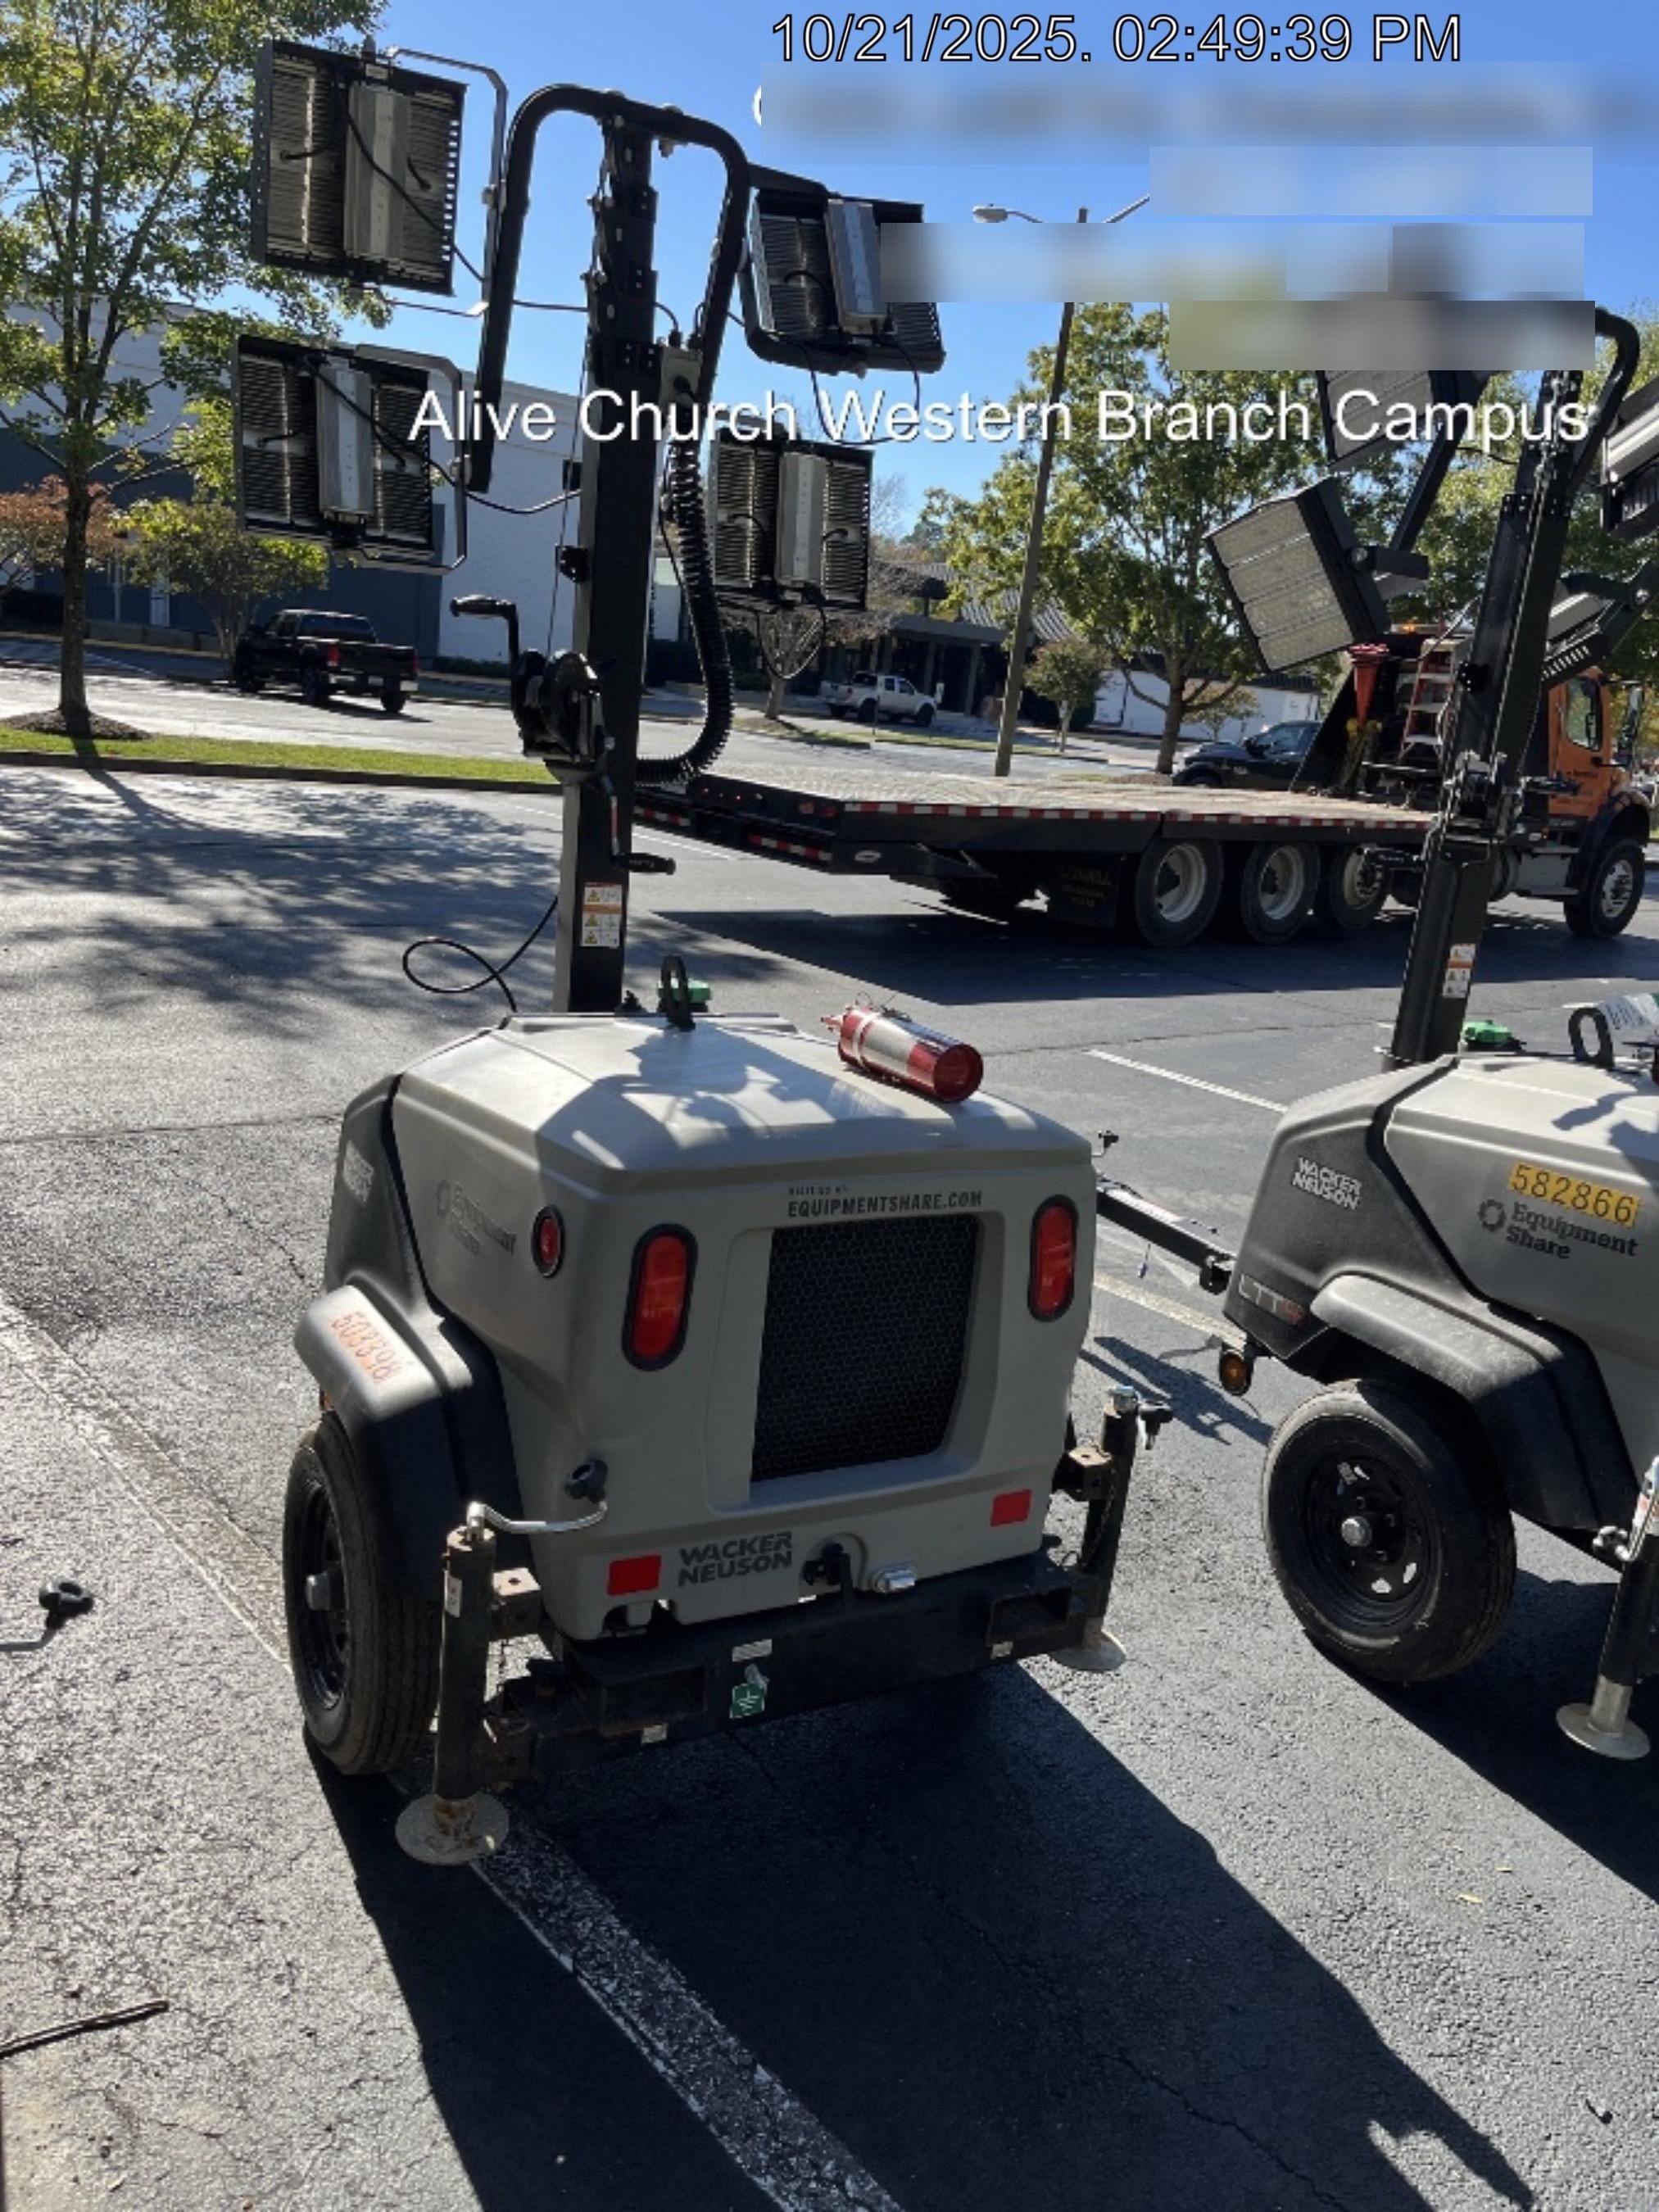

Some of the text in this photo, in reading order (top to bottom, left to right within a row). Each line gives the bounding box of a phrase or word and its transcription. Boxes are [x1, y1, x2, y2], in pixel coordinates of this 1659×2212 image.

[788, 1190, 982, 1218] EQUIPMENTSHARE.COM
[1512, 1164, 1635, 1223] 582866
[1506, 1225, 1571, 1259] Share
[1512, 1201, 1638, 1256] Equipment
[678, 1531, 793, 1566] WACKER
[678, 1551, 793, 1588] NEUSON
